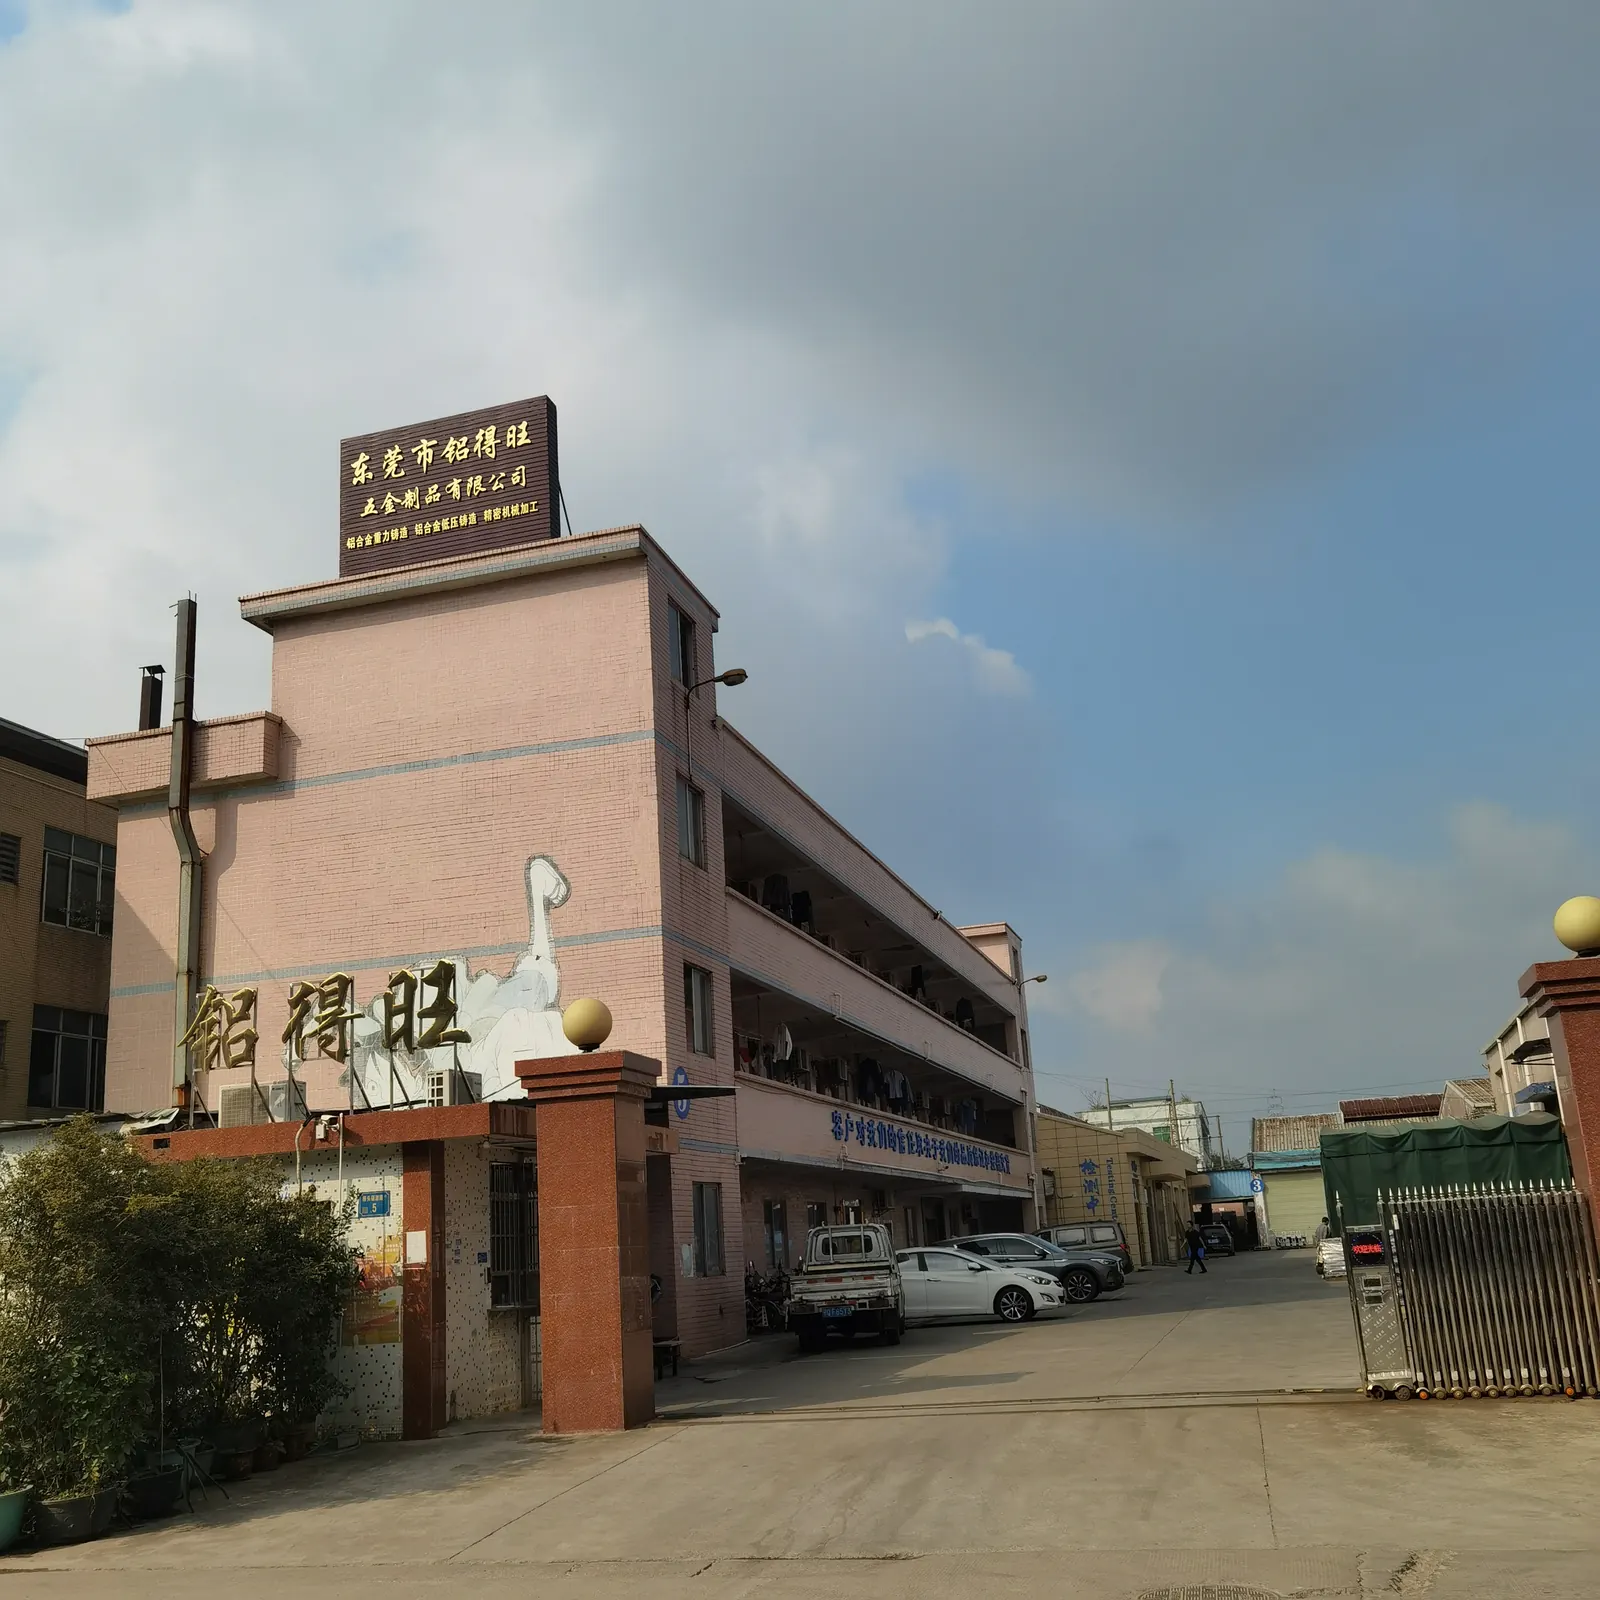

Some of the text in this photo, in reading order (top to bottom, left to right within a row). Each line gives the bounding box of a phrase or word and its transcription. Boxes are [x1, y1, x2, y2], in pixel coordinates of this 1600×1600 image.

[351, 420, 532, 486] 东莞市铝得旺
[360, 465, 528, 518] 五金制品有限公司
[346, 501, 539, 550] 铝合金重力铸造 铝合金低压铸造 精密机械加工
[177, 958, 472, 1073] 铝得旺
[371, 1203, 377, 1213] 5
[1253, 1179, 1262, 1192] 3
